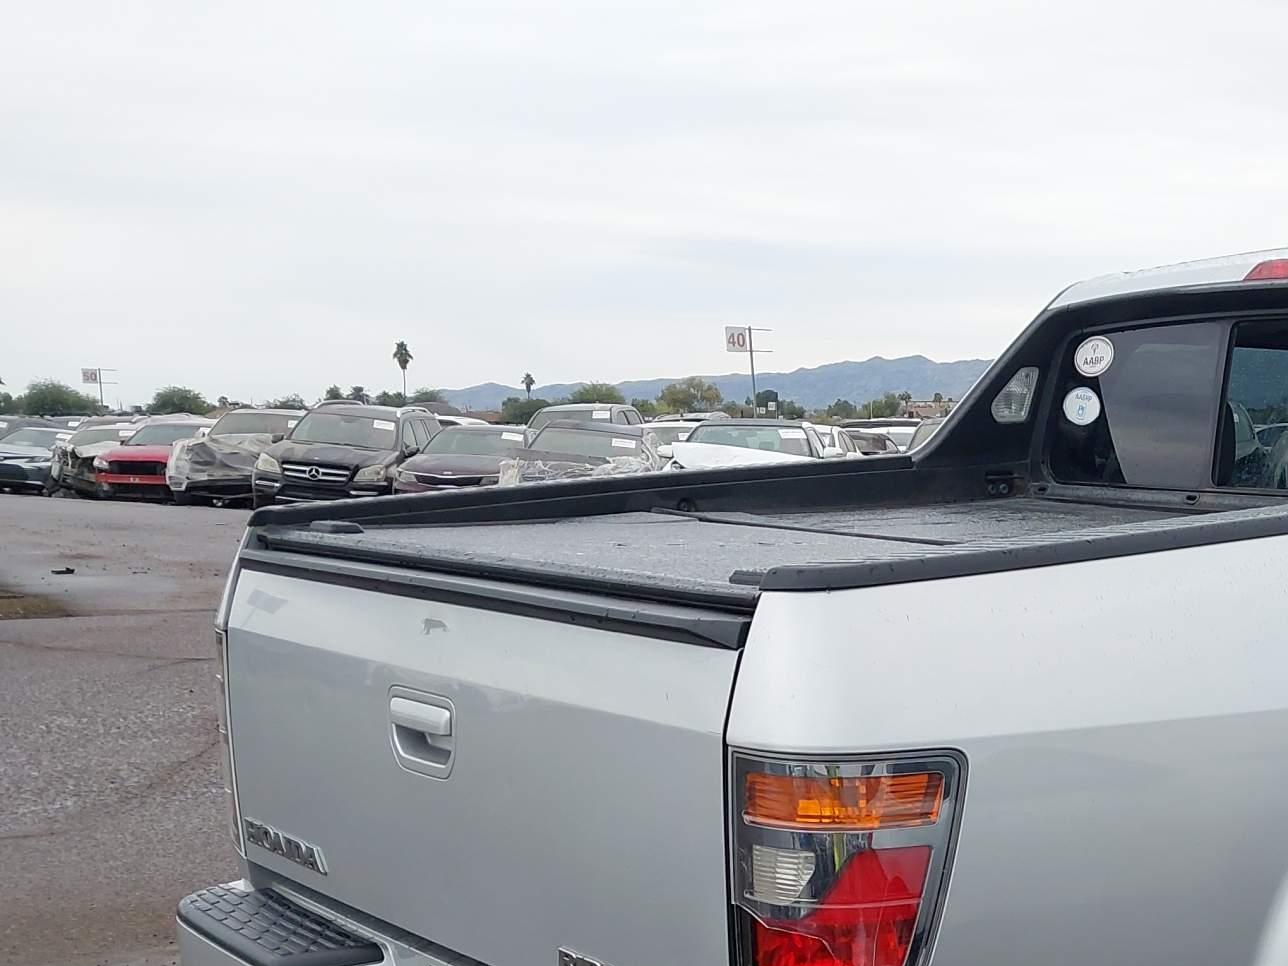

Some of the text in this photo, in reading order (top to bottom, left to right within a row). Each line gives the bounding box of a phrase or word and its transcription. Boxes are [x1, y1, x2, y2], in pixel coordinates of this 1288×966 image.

[728, 333, 746, 347] 40
[1083, 355, 1105, 367] AABP
[244, 817, 329, 876] HONDA
